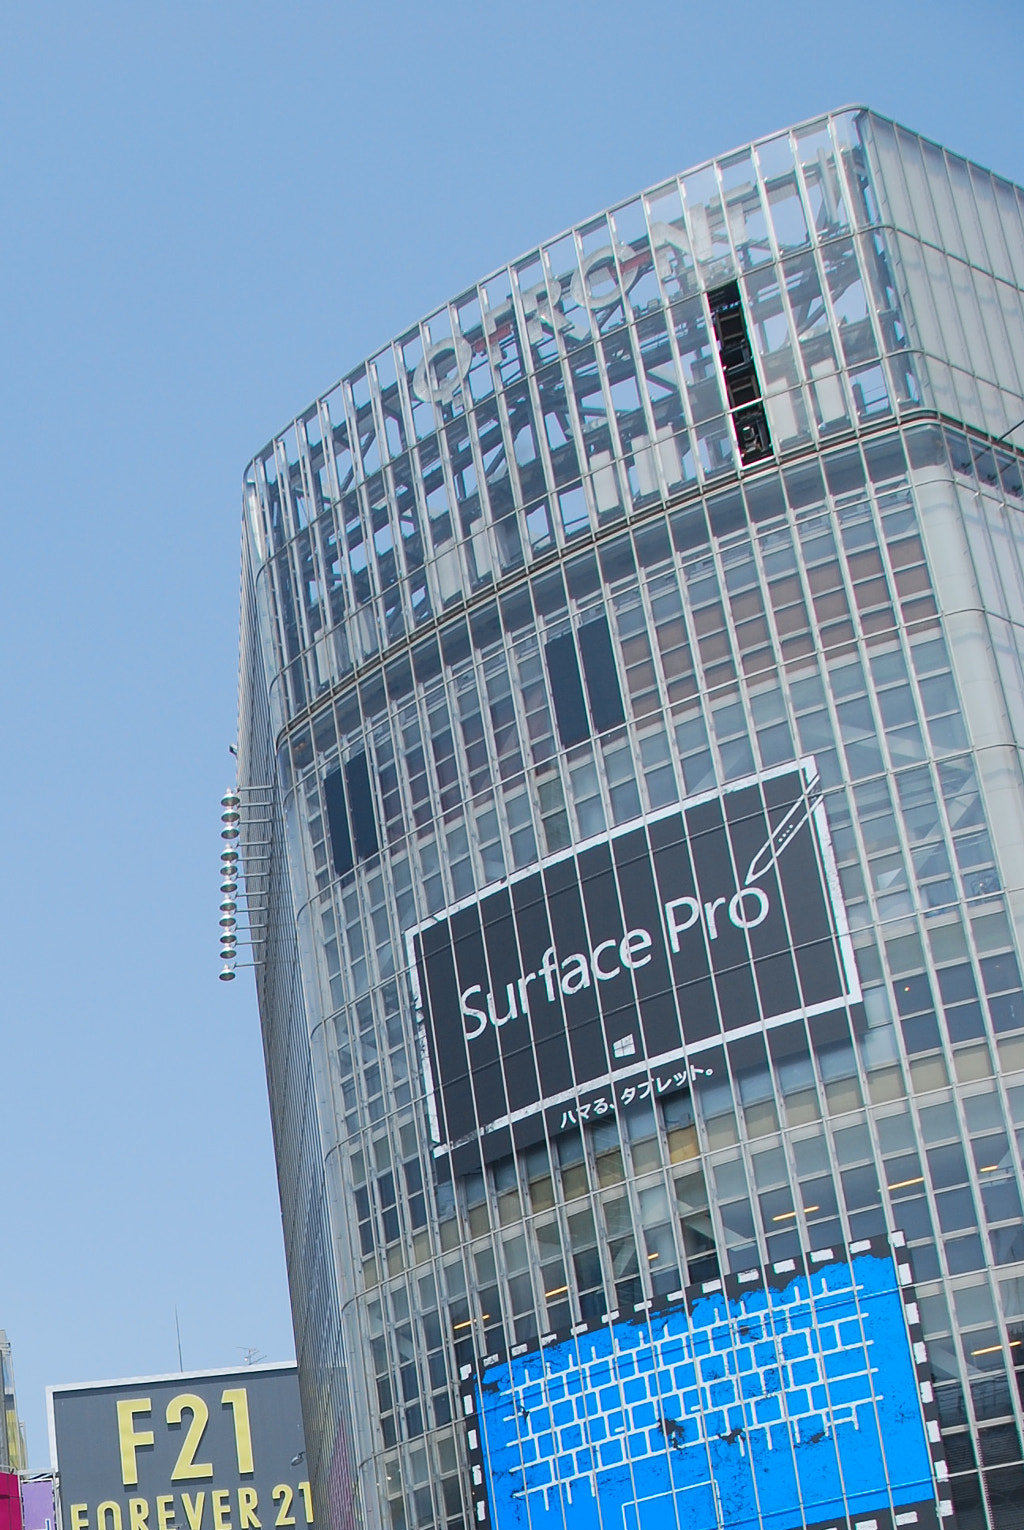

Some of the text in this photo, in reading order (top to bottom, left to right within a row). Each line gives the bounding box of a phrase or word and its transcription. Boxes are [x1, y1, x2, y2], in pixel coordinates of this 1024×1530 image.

[460, 882, 770, 1041] Surface Pro
[116, 1388, 254, 1485] F21
[272, 1481, 314, 1526] 21
